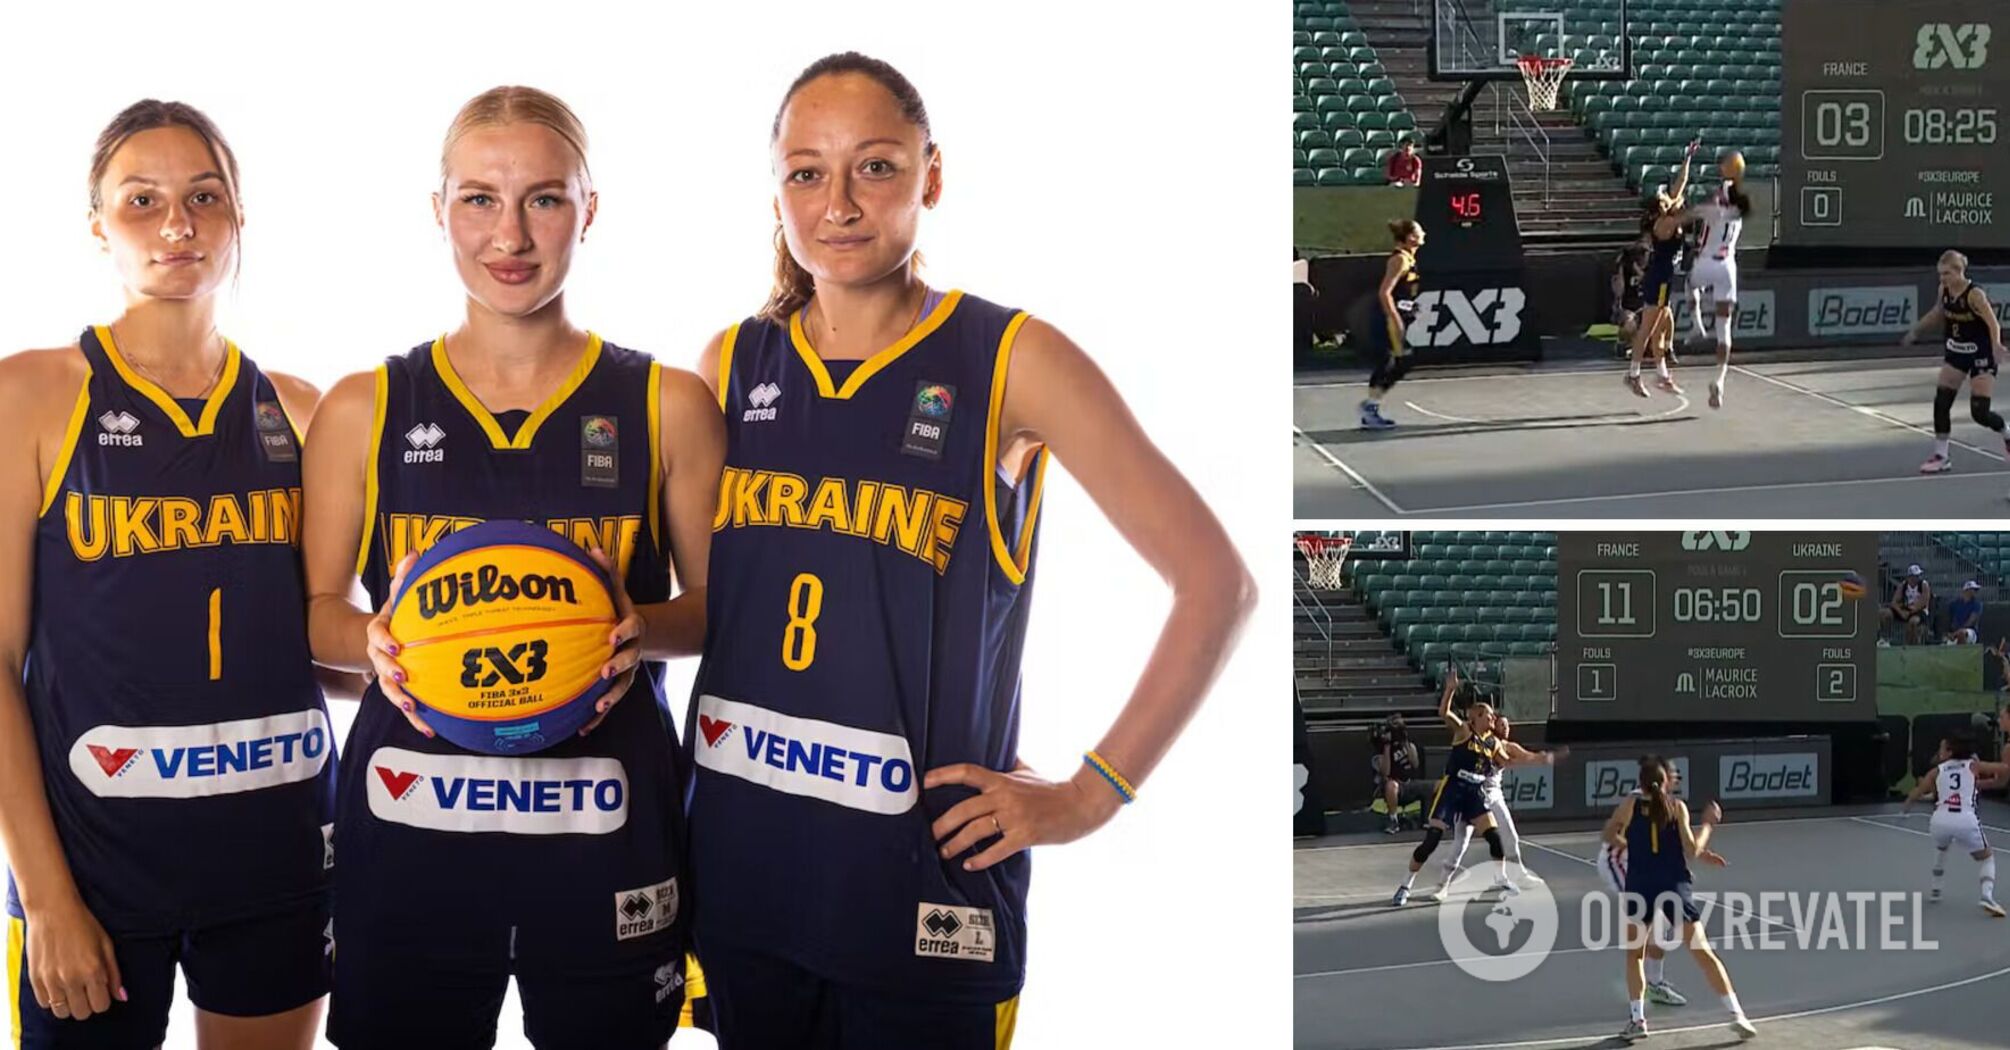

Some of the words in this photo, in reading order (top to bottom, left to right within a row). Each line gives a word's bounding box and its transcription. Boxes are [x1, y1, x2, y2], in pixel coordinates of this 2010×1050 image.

[1824, 63, 1869, 76] FRANCE
[1816, 103, 1870, 146] 03
[1904, 109, 1998, 143] 08:25
[1807, 171, 1837, 182] FOULS
[1814, 194, 1828, 218] 0
[1936, 193, 1993, 207] MAURICE
[1936, 210, 1993, 224] LACROIX
[1815, 294, 1912, 327] Bodet
[912, 422, 941, 440] FIBA
[587, 455, 613, 468] FIBA
[65, 487, 302, 562] UKRAIN
[1597, 543, 1639, 557] FRANCE
[1793, 543, 1842, 557] UKRAINE
[416, 565, 577, 620] Wilson
[1598, 583, 1636, 624] 11
[1674, 588, 1761, 621] 06:50
[1793, 583, 1843, 625] 02
[782, 573, 824, 671] 8
[208, 587, 222, 681] 1
[1583, 648, 1611, 659] FOULS
[1688, 648, 1745, 659] #3X3EUROPE
[1823, 648, 1851, 659] FOULS
[1591, 670, 1602, 693] 1
[1706, 669, 1758, 682] MAURICE
[1830, 670, 1843, 694] 2
[480, 690, 506, 700] FIBA
[1706, 684, 1758, 698] LACROIX
[468, 698, 516, 709] OFFICIAL
[519, 694, 544, 705] BALL
[151, 727, 325, 778] VENETO
[743, 725, 912, 793] VENETO
[1725, 761, 1812, 792] Bodet
[1949, 773, 1961, 790] 3
[431, 776, 623, 812] VENETO
[918, 938, 960, 955] errea
